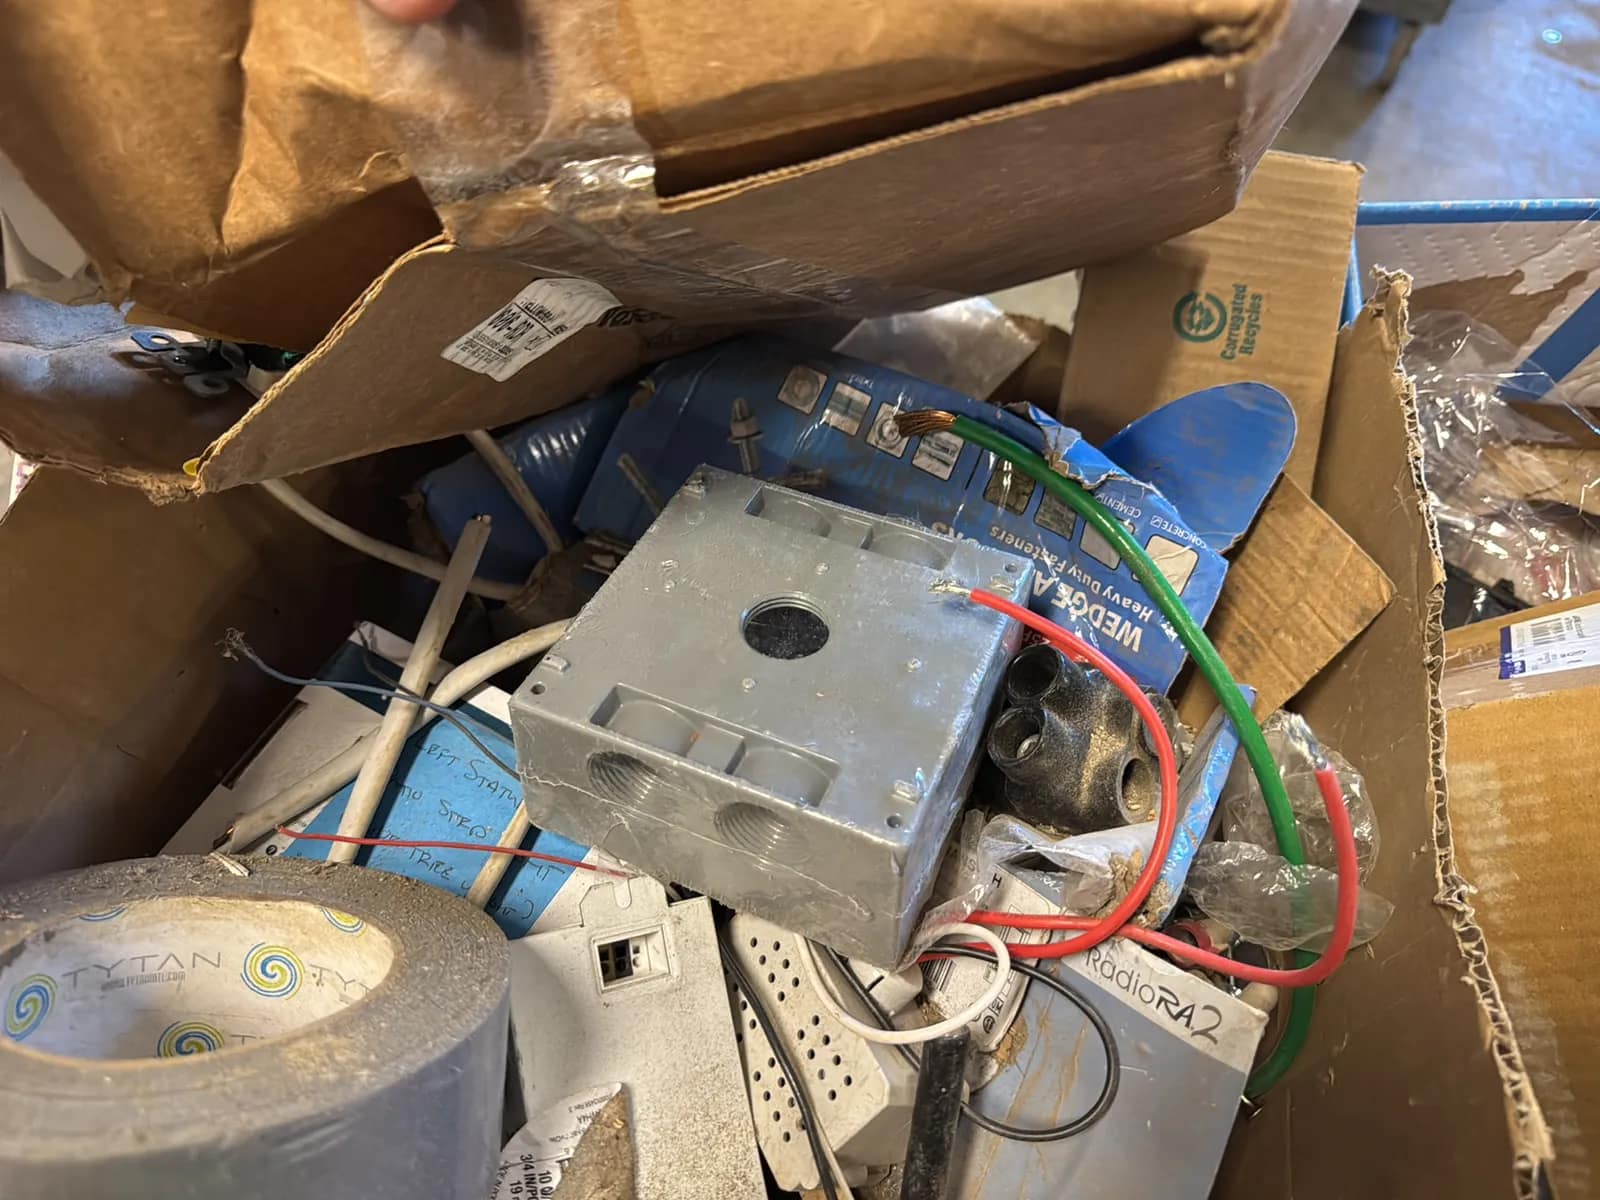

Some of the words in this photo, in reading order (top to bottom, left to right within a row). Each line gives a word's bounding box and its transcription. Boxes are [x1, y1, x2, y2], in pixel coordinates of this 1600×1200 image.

[1220, 283, 1248, 361] Corrugated
[1239, 293, 1263, 356] Recycles
[1103, 494, 1141, 519] CEMENT
[989, 525, 1067, 574] Fasteners
[1067, 565, 1102, 597] Duty
[1051, 584, 1144, 653] WEDGE
[1103, 586, 1153, 623] Heavy
[61, 951, 222, 988] TYTAN
[520, 1153, 535, 1171] 3/4
[538, 1170, 552, 1184] 10
[509, 1180, 523, 1195] 19
